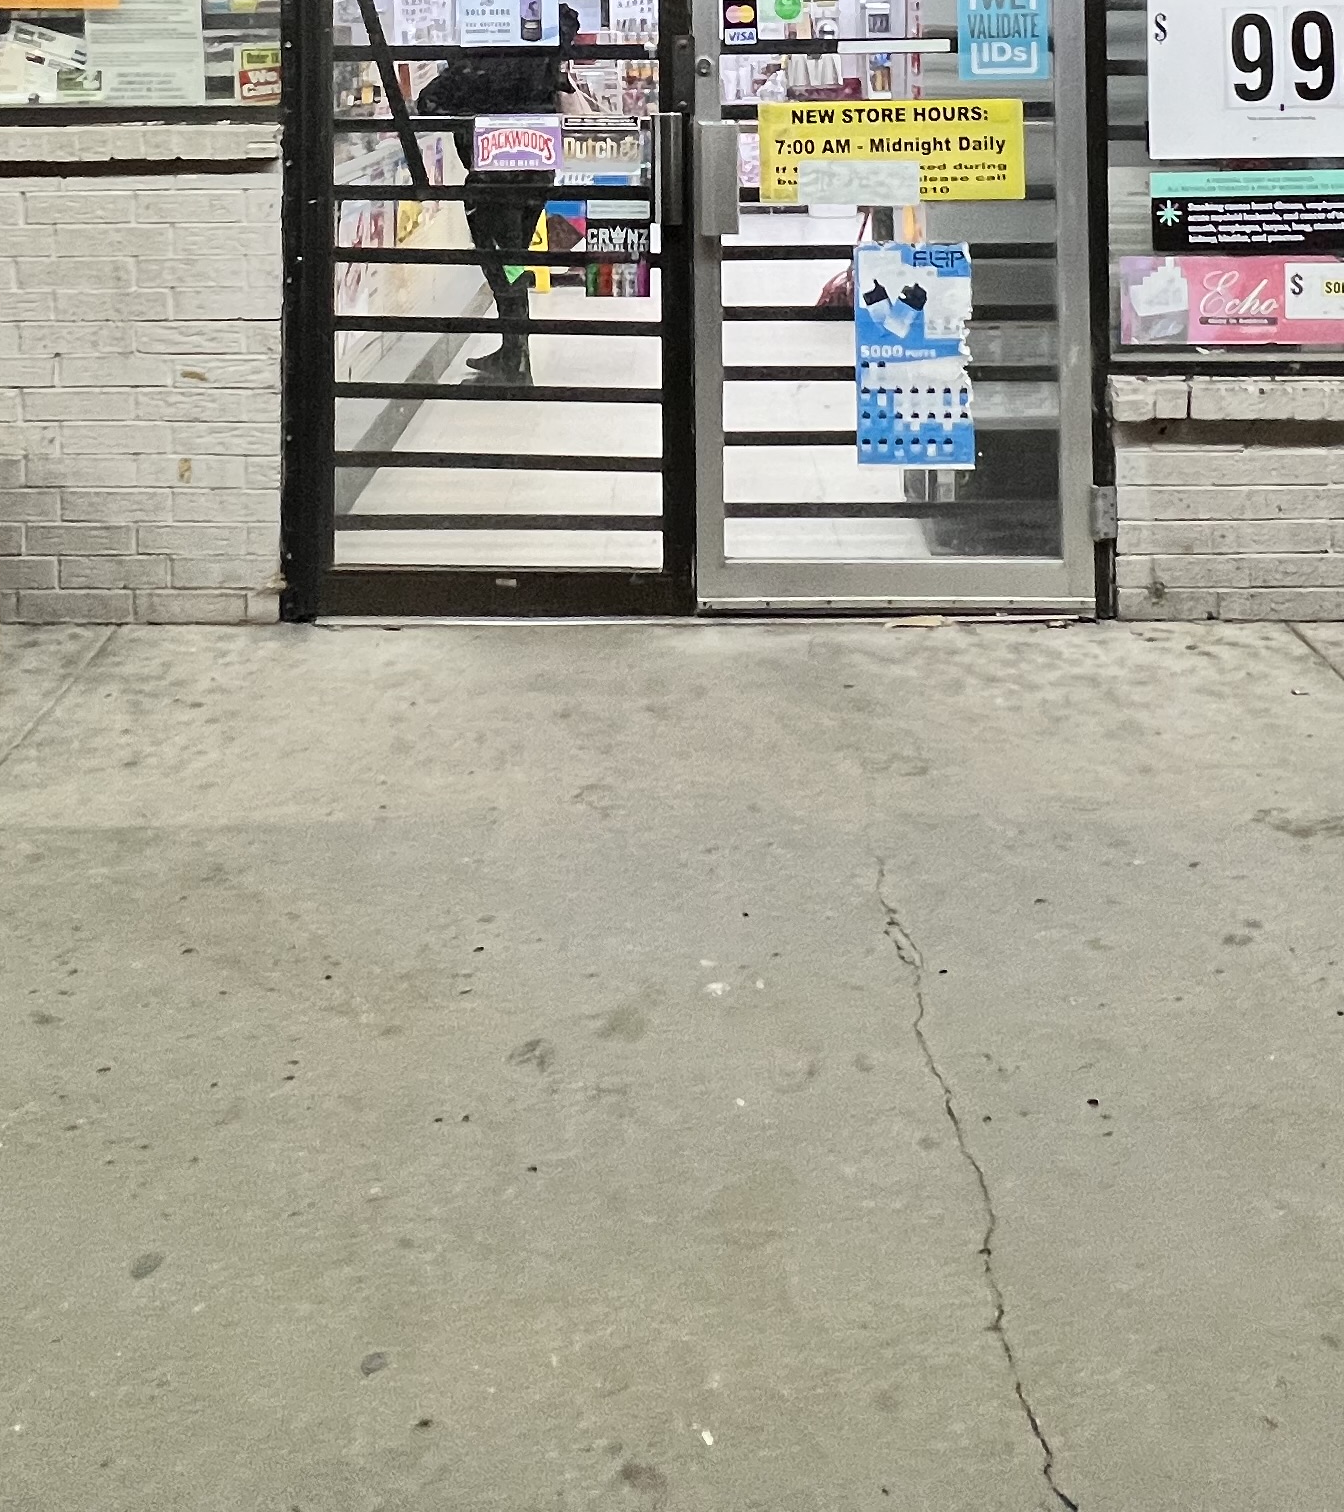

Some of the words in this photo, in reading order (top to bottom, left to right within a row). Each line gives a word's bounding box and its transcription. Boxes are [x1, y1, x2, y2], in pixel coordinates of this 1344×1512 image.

[728, 31, 755, 42] VISA
[967, 13, 1040, 39] VALIDATE
[1154, 12, 1168, 44] $
[982, 41, 1028, 62] IDs
[791, 109, 835, 124] NEW
[841, 108, 906, 123] STORE
[913, 106, 989, 122] HOURS:
[479, 129, 554, 164] BACKWOODS
[564, 137, 618, 160] Dutch
[775, 139, 815, 155] 7:00
[821, 139, 851, 154] AM
[869, 137, 952, 155] Midnight
[958, 136, 1006, 154] Daily
[953, 162, 1007, 171] during
[975, 173, 1006, 182] call
[1199, 270, 1280, 317] Echo
[1290, 273, 1304, 296] $
[860, 344, 904, 358] 5000
